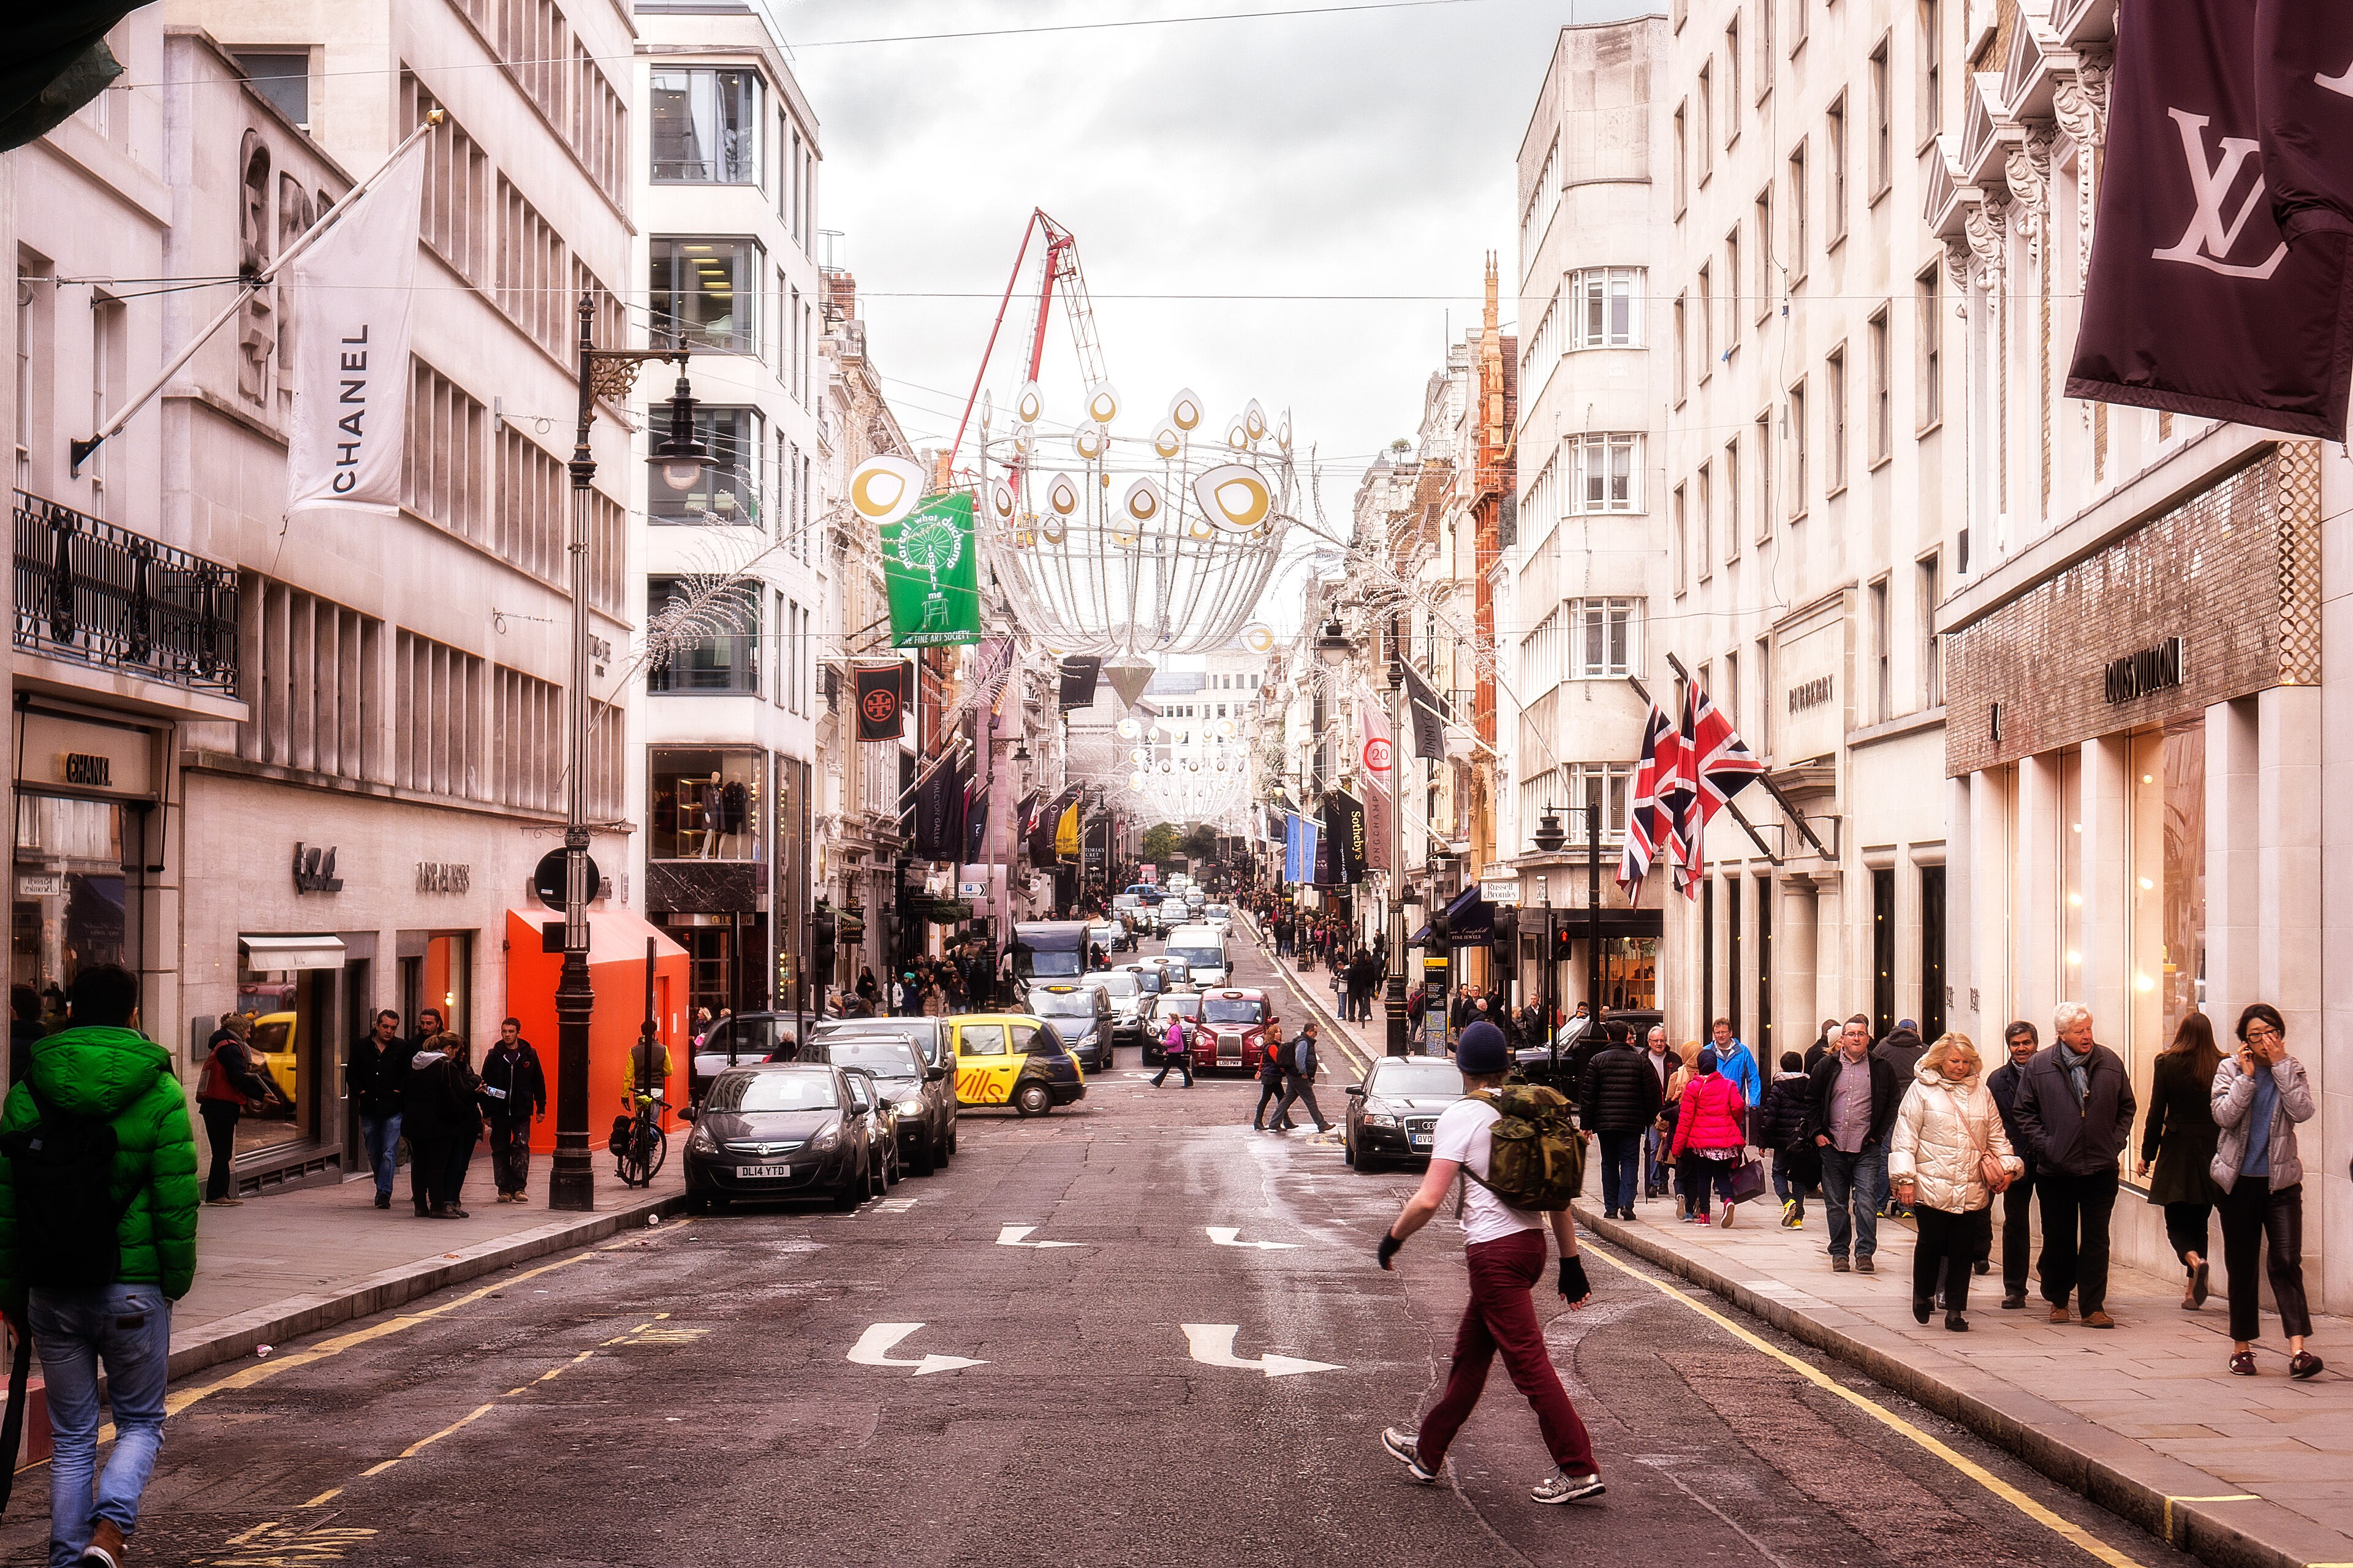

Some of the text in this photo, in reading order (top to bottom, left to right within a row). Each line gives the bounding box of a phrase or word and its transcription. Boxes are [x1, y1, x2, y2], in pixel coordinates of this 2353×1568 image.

[2151, 106, 2288, 279] LV
[333, 324, 369, 494] CHANEL
[914, 513, 938, 525] what
[941, 515, 964, 569] duchamp
[927, 543, 938, 591] taught
[928, 591, 942, 600] me
[914, 634, 929, 644] FINE
[930, 634, 942, 643] ART
[944, 630, 970, 642] SOCIETY
[2131, 637, 2183, 699] VUITTON
[1788, 673, 1834, 715] BURBERRY
[1416, 684, 1435, 757] JIMMY COO
[66, 752, 112, 787] CHANEL
[1371, 748, 1389, 761] 20
[1351, 811, 1365, 860] Sotheby's
[1372, 795, 1381, 869] LONGCHAMP
[847, 897, 858, 908] 148
[1483, 890, 1517, 900] Bromley
[742, 1166, 784, 1176] DL14 YTD
